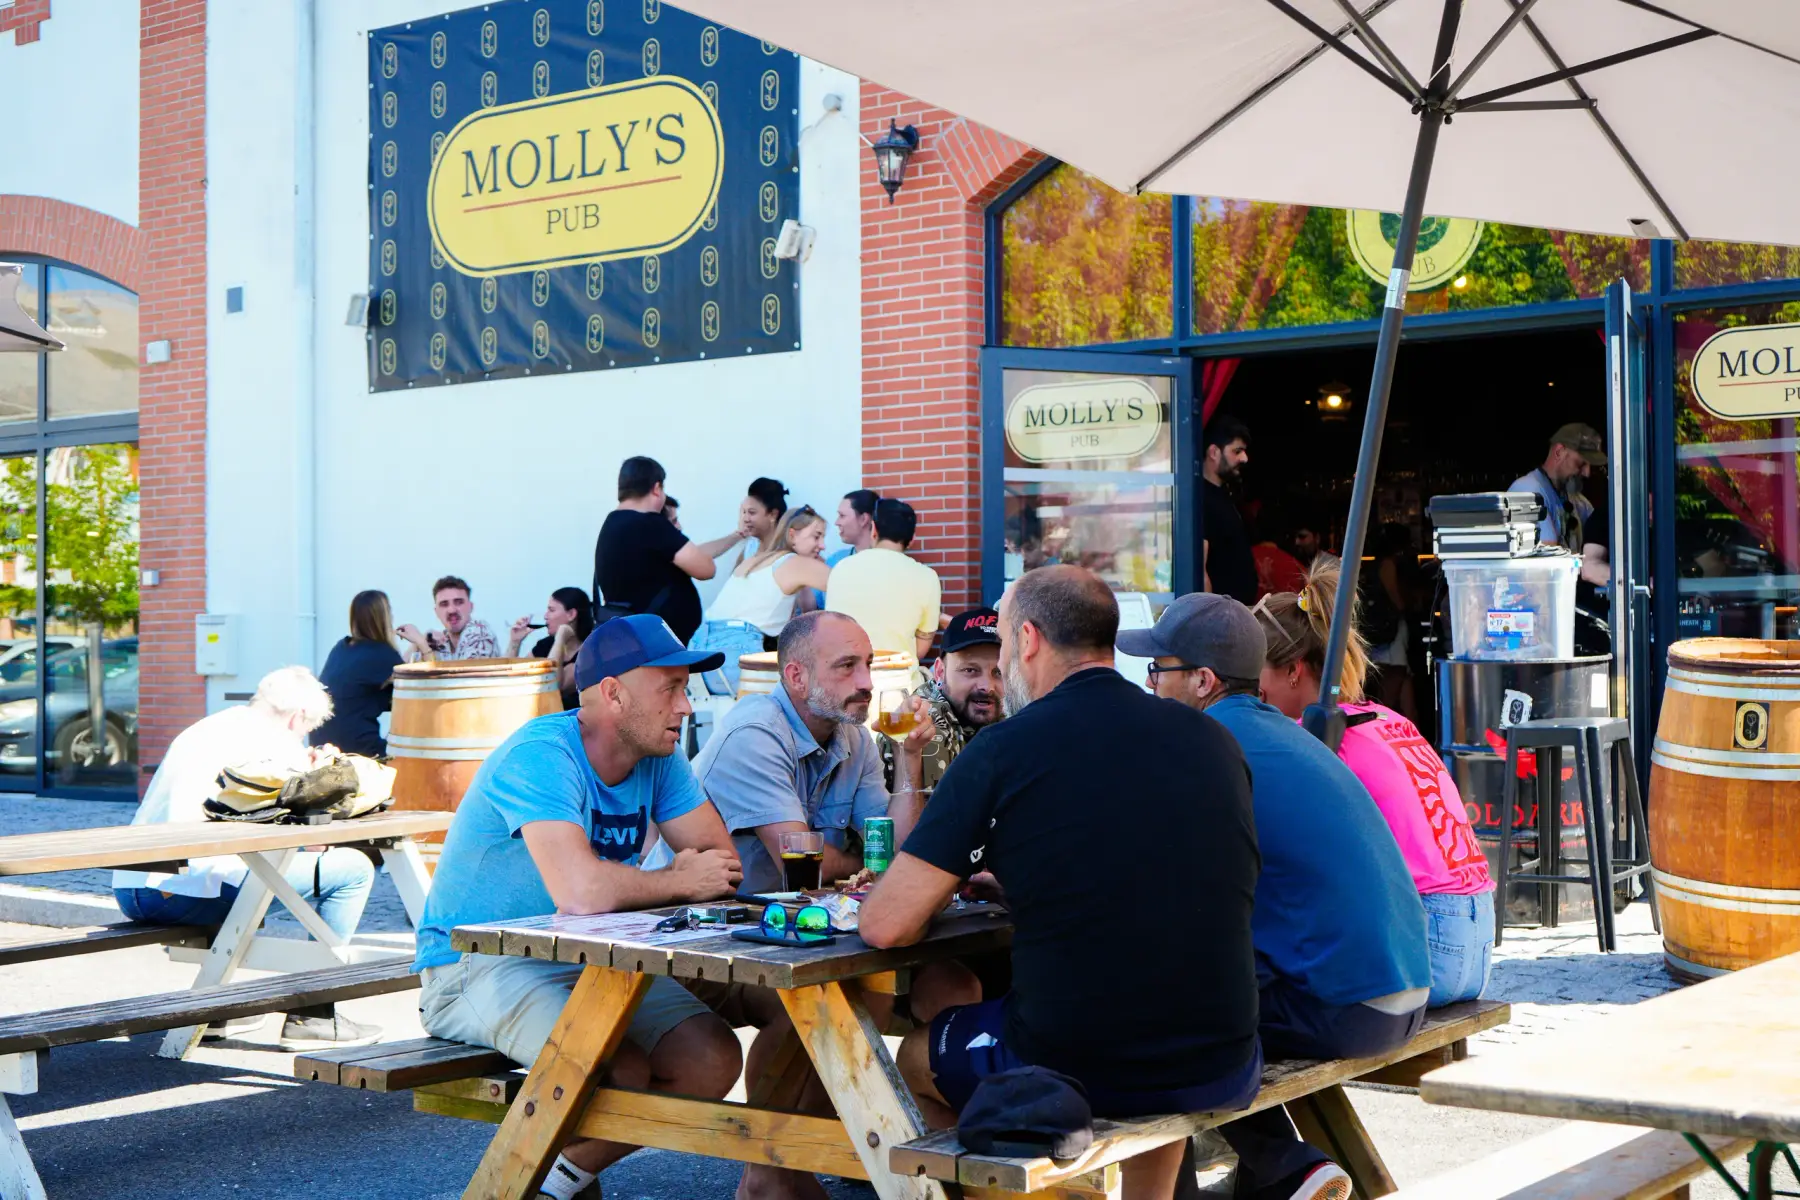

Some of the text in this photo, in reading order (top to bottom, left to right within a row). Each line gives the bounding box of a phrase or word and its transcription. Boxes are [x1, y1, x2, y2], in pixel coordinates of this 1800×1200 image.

[461, 112, 687, 198] MOLLY'S
[545, 203, 601, 235] PUB
[1024, 397, 1144, 428] MOLLY'S
[1070, 434, 1100, 448] PUB
